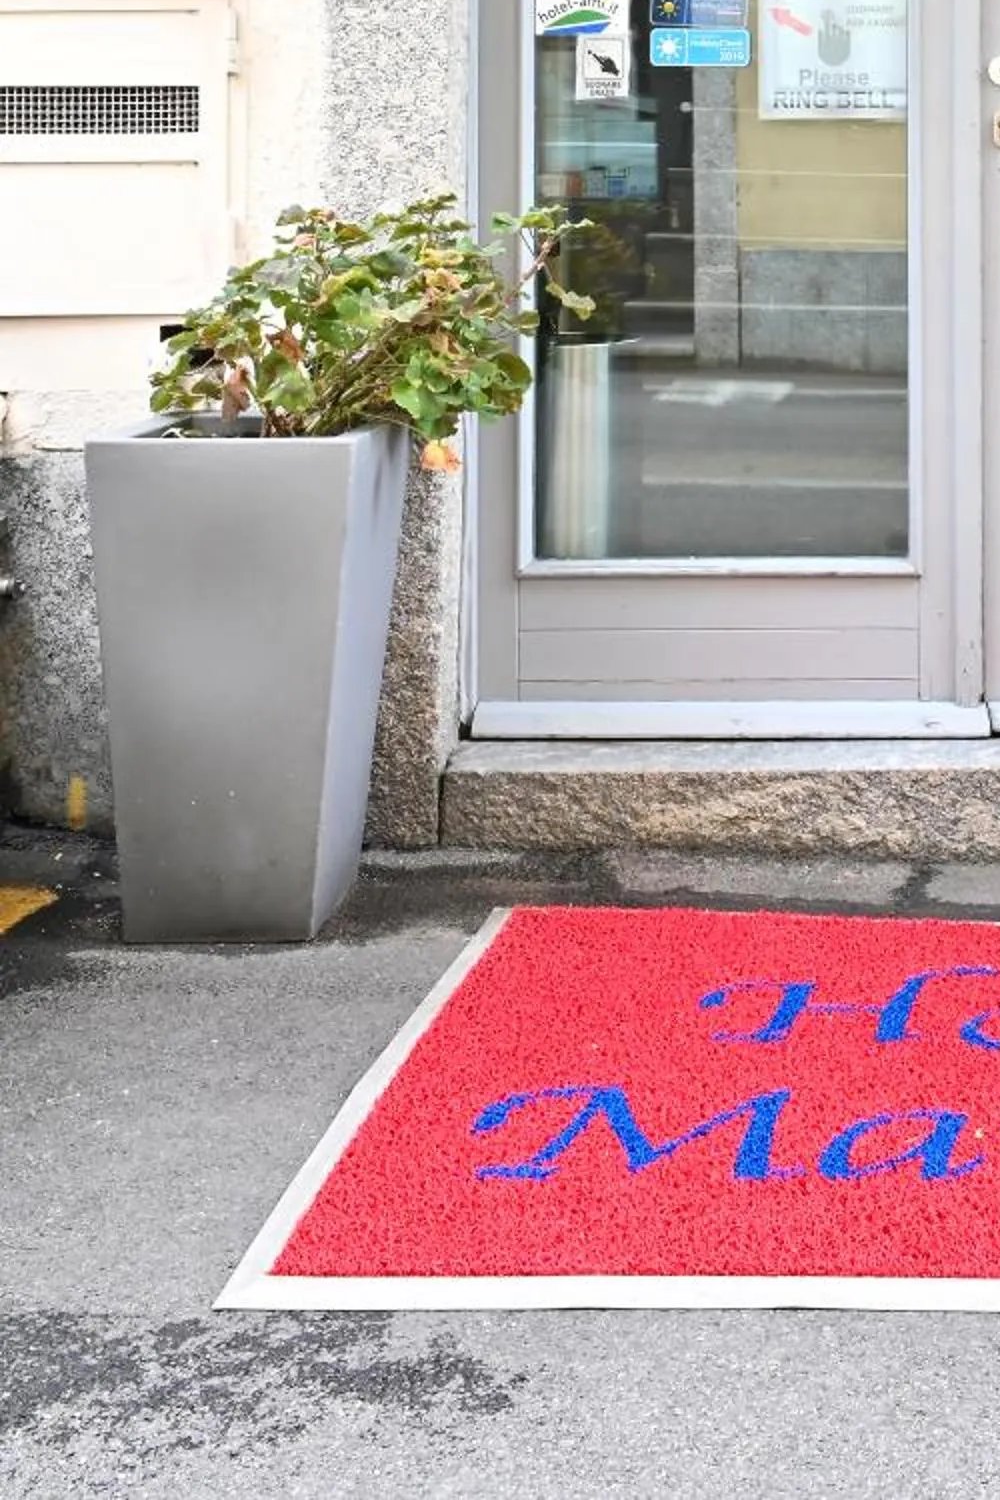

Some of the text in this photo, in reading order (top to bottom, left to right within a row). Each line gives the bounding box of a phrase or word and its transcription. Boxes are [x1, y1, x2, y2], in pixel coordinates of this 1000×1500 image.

[798, 68, 870, 87] Please
[773, 90, 896, 109] RING BELL
